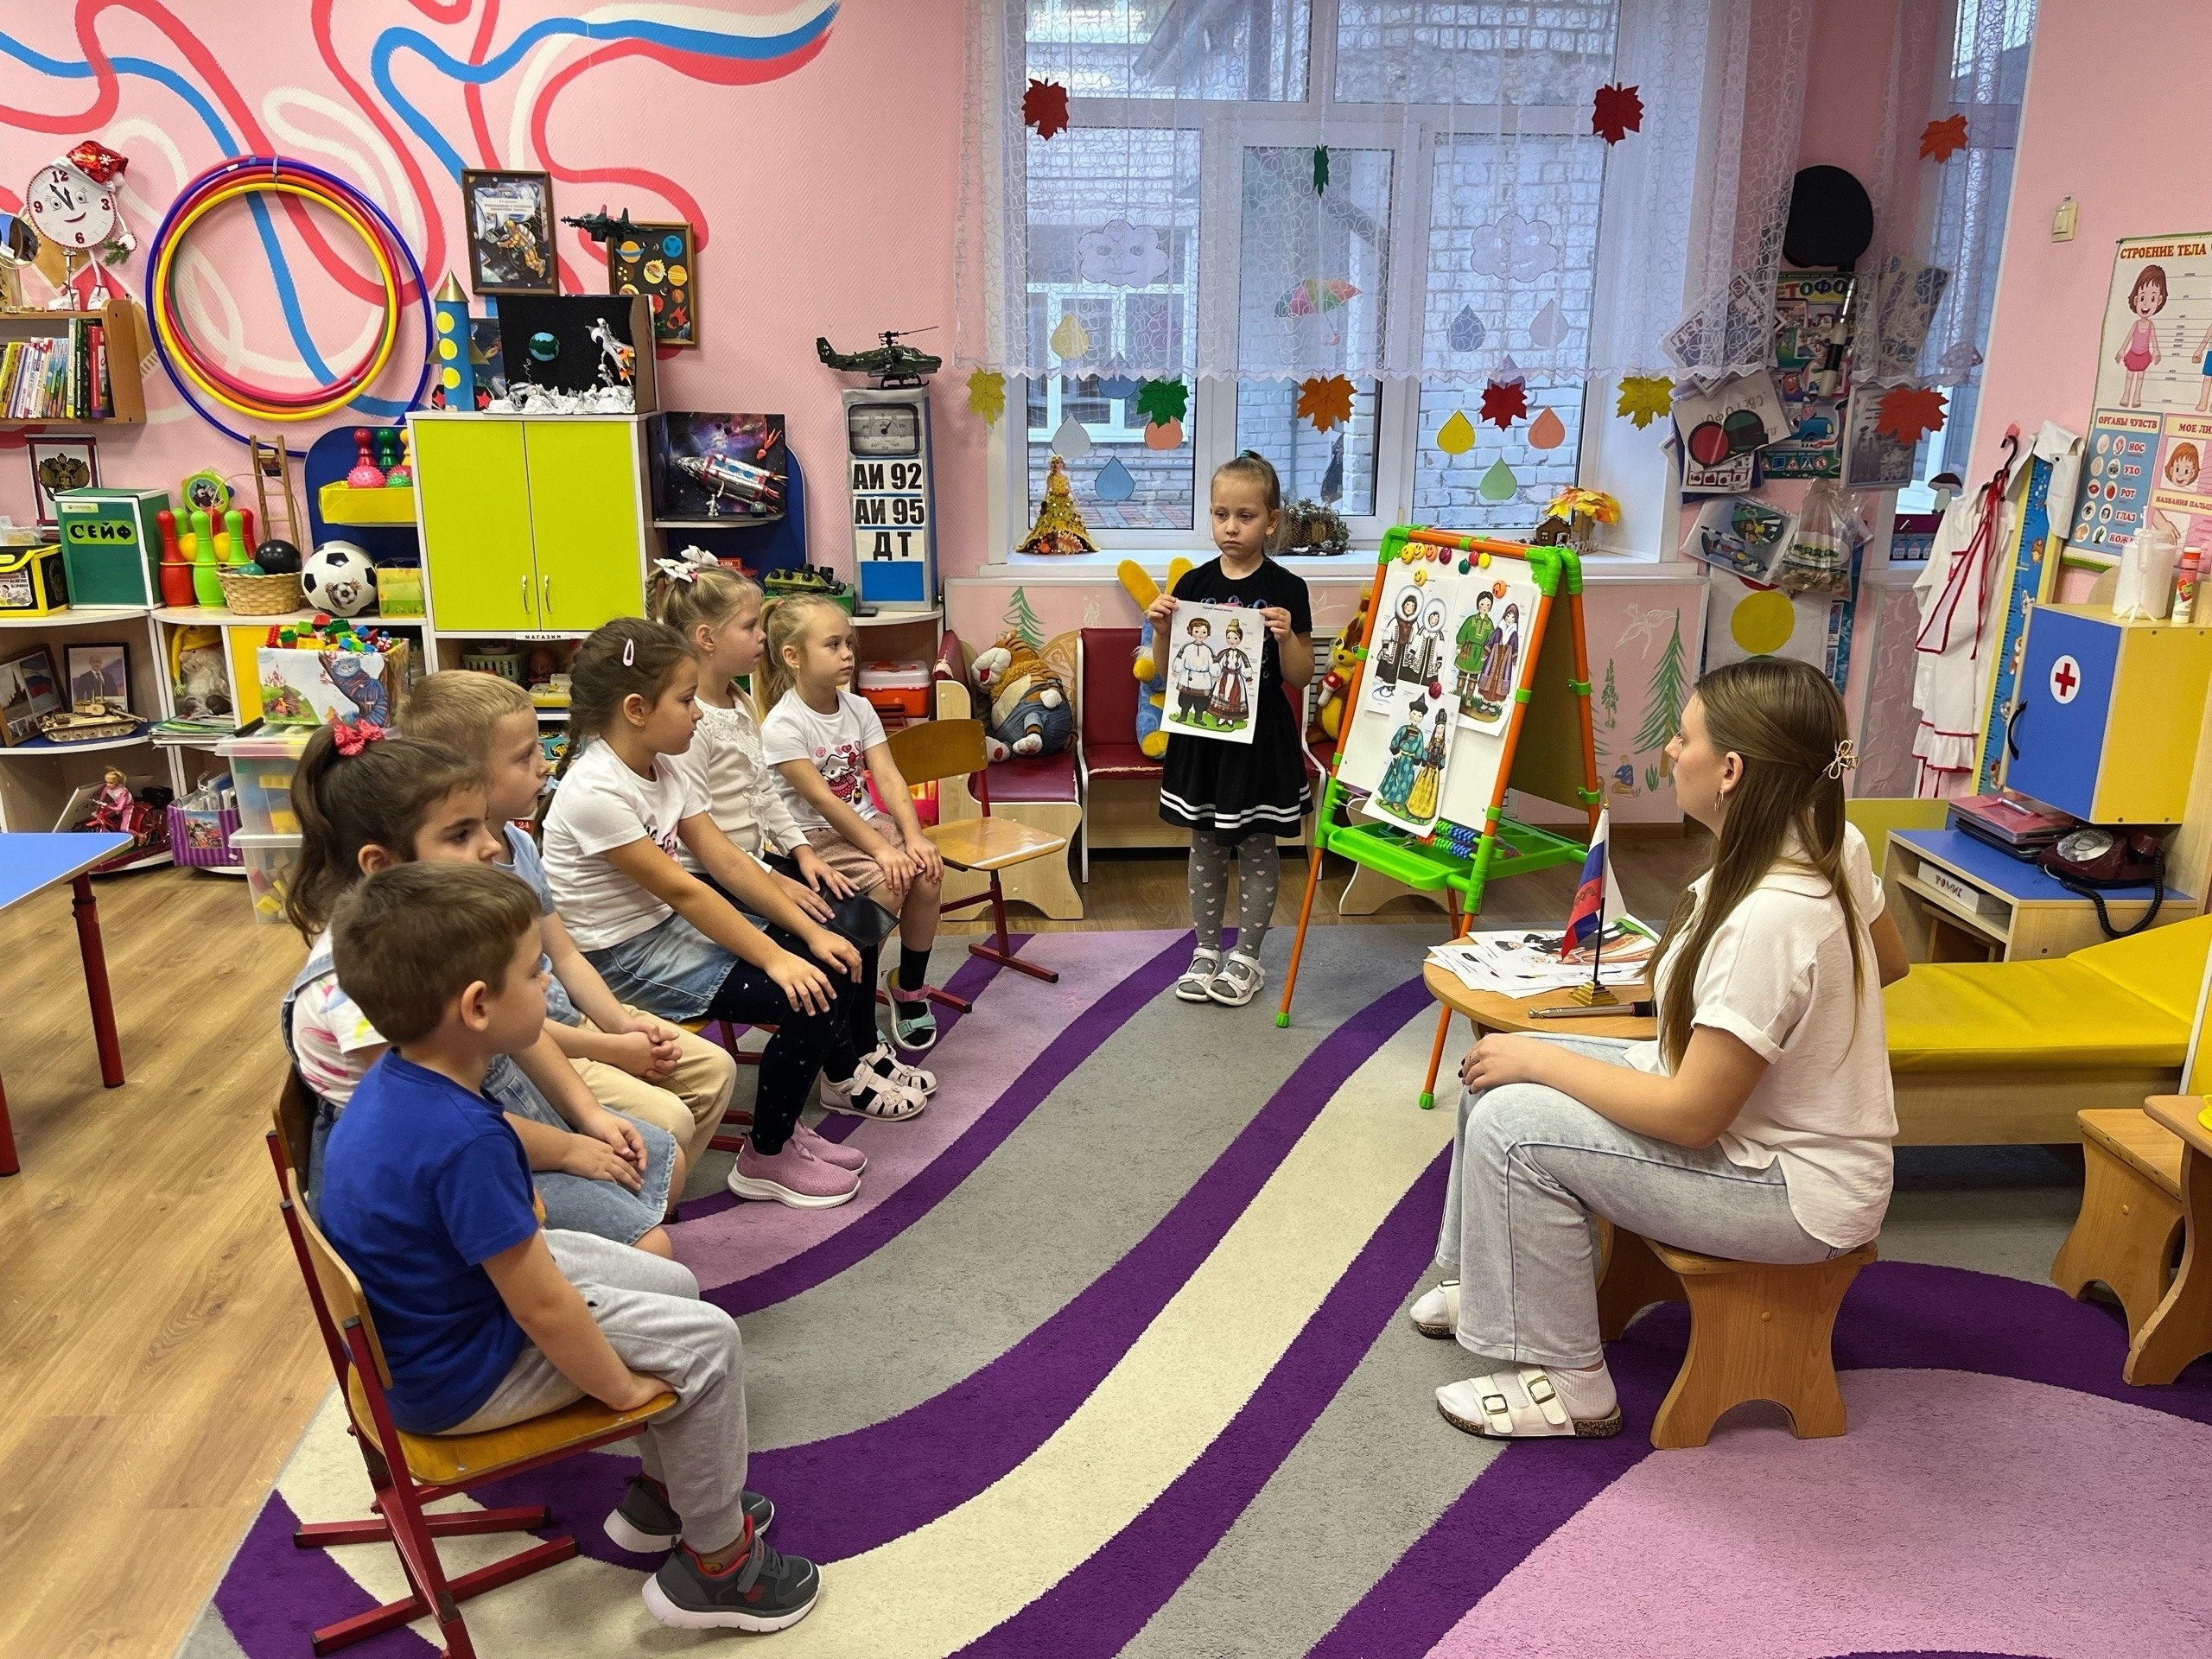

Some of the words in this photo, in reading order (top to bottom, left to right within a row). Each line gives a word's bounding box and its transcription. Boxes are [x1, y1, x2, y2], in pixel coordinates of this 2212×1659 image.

[52, 170, 69, 183] 12
[33, 200, 43, 213] 9
[100, 198, 111, 211] 3
[75, 232, 85, 244] 6
[2120, 245, 2174, 259] СТРОЕНИЕ
[2177, 244, 2207, 256] ТЕЛА
[2098, 416, 2127, 426] ОРГАНЫ
[2130, 419, 2158, 429] ЧУВСТВ
[2178, 423, 2197, 433] МОЕ
[2199, 425, 2212, 435] ЛИ
[2128, 442, 2145, 452] НОС
[853, 463, 885, 490] АИ
[891, 462, 922, 490] 92
[2124, 466, 2141, 475] УХО
[2120, 488, 2136, 499] РОТ
[2156, 496, 2189, 506] НАЗВАНИЯ
[855, 499, 886, 524] АИ
[893, 498, 925, 524] 95
[2116, 512, 2136, 522] ГЛАЗ
[70, 522, 132, 540] СЕЙФ
